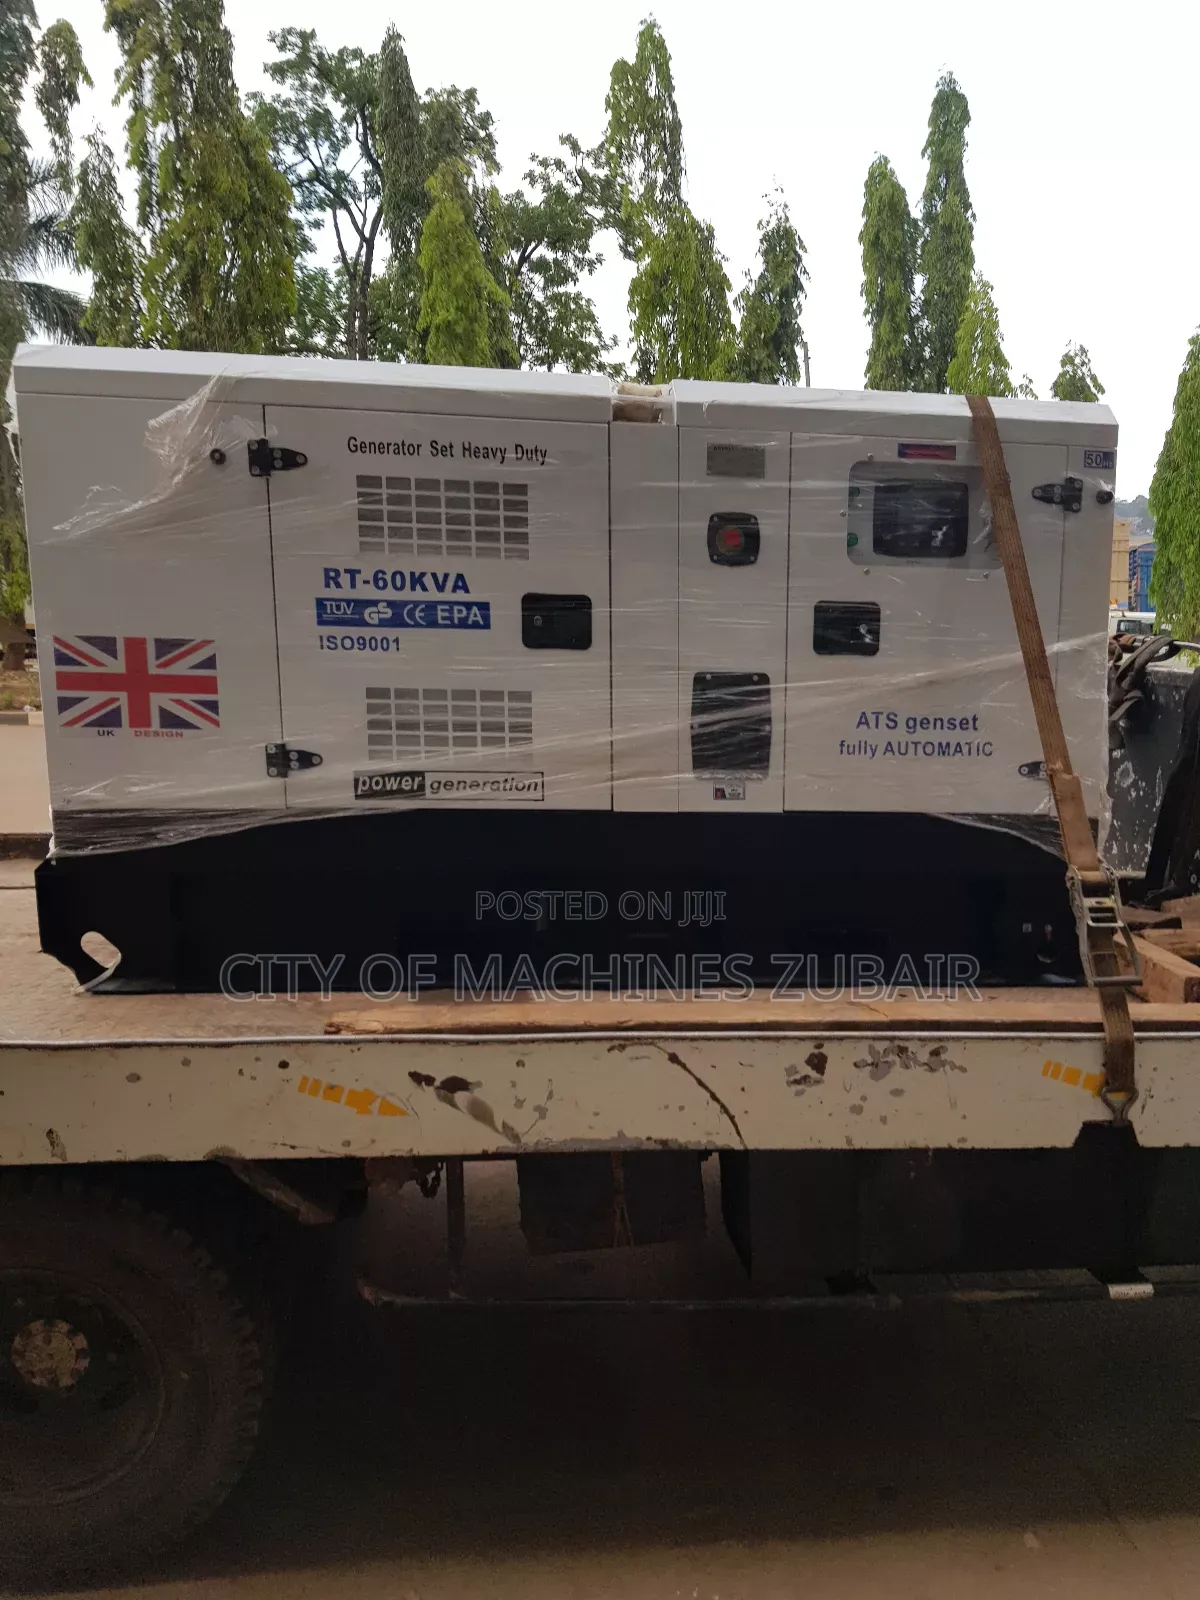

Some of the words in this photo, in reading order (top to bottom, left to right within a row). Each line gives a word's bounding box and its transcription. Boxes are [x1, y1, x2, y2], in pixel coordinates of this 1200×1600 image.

[347, 436, 422, 457] Generator
[429, 440, 454, 458] Set
[462, 441, 507, 465] Heavy
[515, 443, 548, 466] Duty
[323, 567, 471, 594] RT-60KVA
[437, 605, 485, 626] EPA
[319, 635, 401, 652] ISO9001
[856, 711, 899, 731] ATS
[905, 713, 979, 735] genset
[97, 729, 115, 737] UK
[134, 730, 184, 739] DESIGN
[839, 739, 878, 760] fully
[883, 741, 994, 758] AUTOMATIC
[356, 773, 424, 794] power
[429, 775, 539, 794] generation
